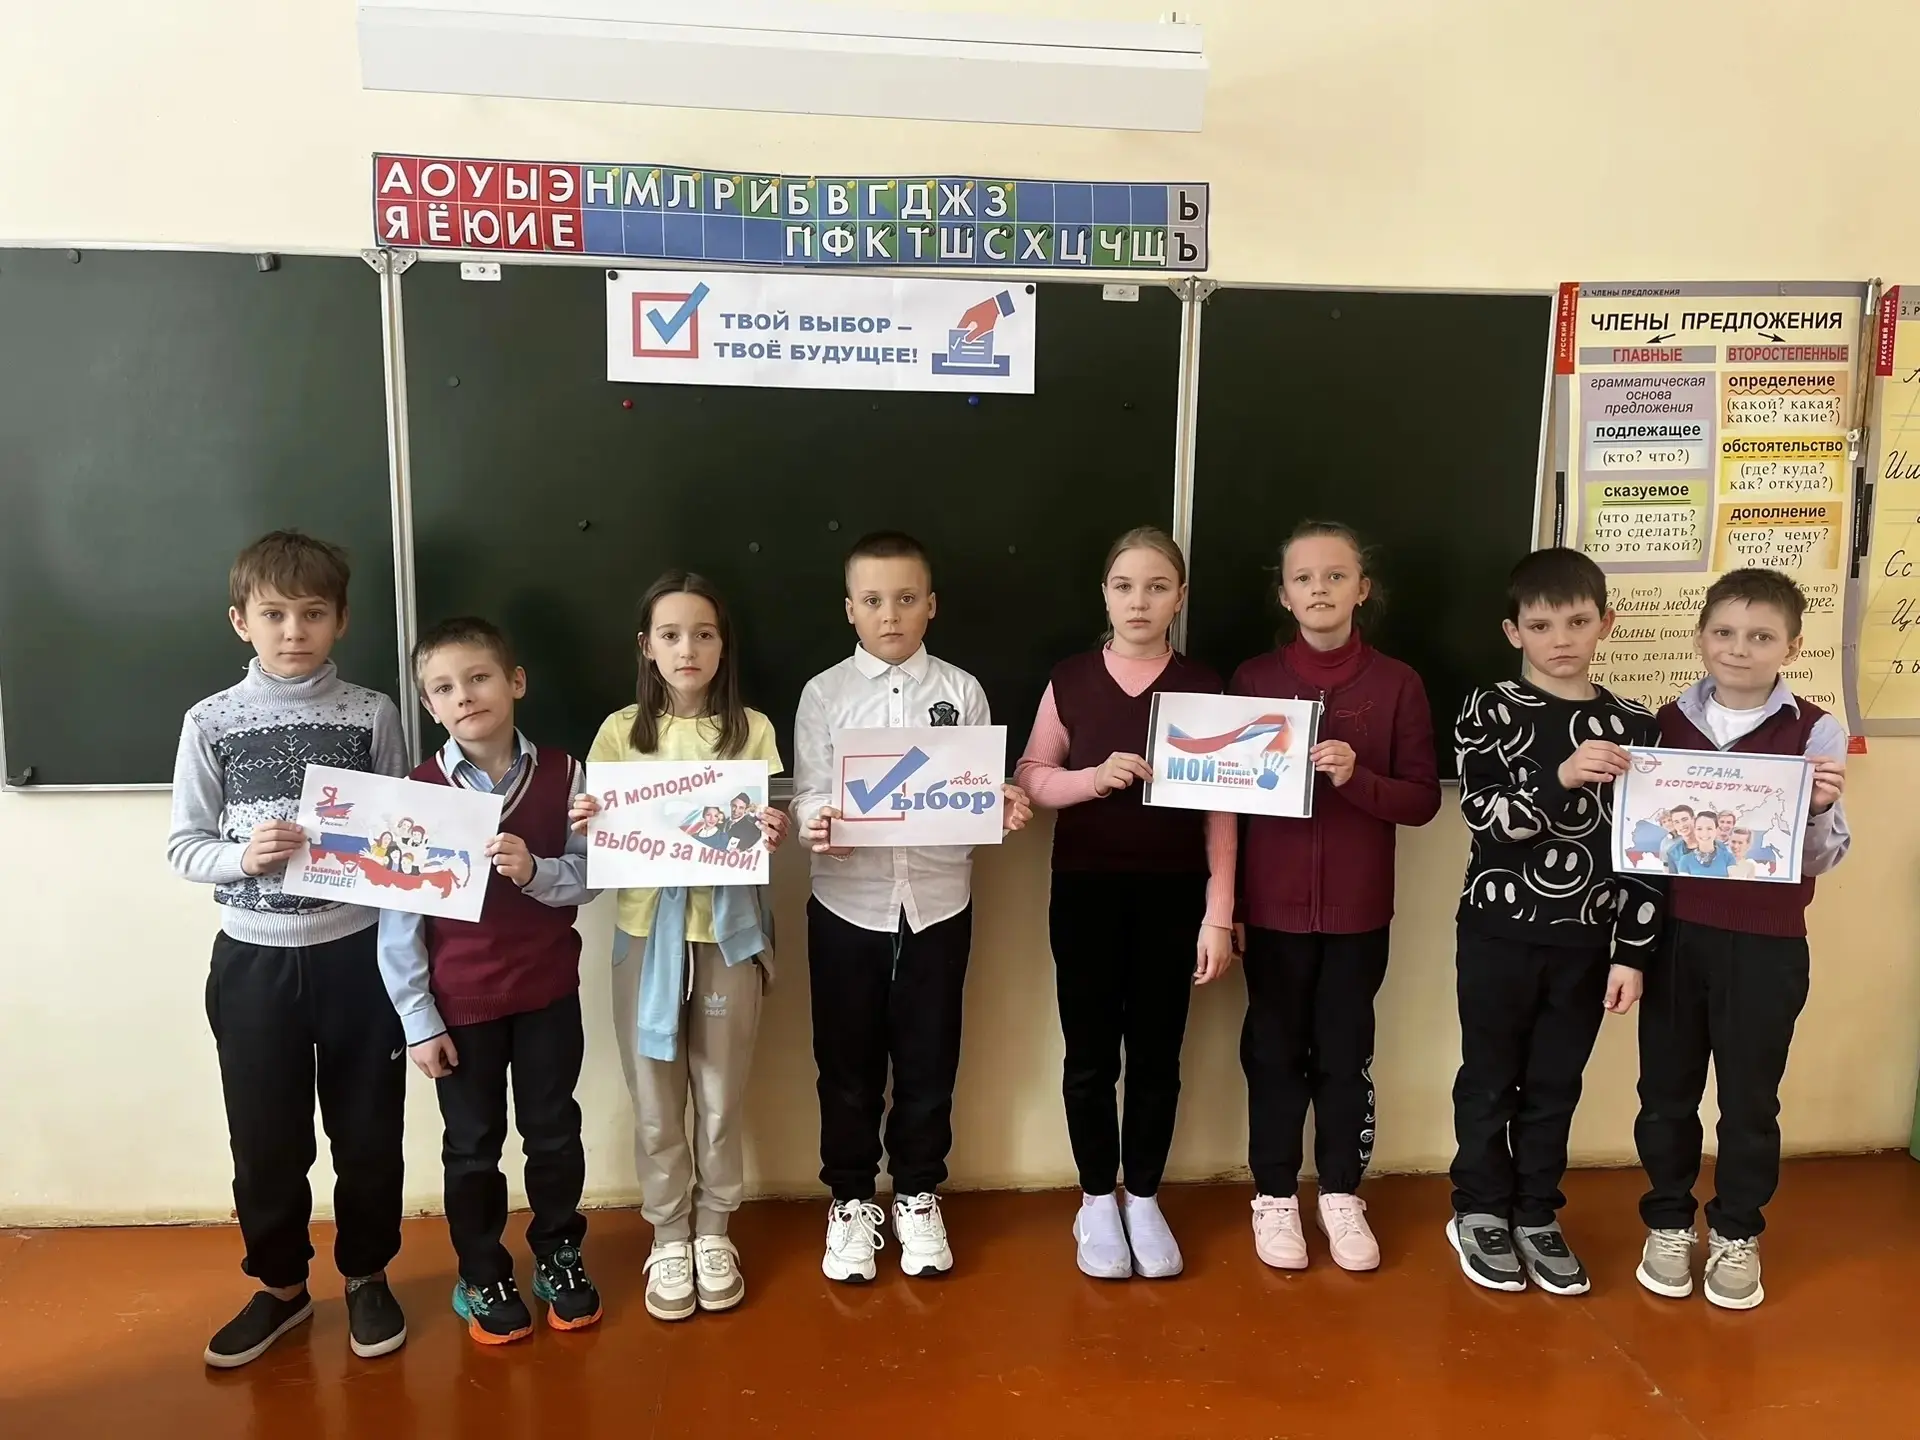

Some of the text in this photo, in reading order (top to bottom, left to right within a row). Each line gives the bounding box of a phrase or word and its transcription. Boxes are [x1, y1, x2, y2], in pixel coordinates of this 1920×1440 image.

[380, 161, 413, 195] А
[420, 163, 456, 198] О
[464, 164, 495, 199] У
[505, 167, 538, 201] Ы
[549, 169, 575, 203] Э
[586, 170, 615, 206] Н
[623, 171, 660, 207] М
[666, 174, 696, 209] Л
[714, 178, 736, 210] Р
[750, 178, 779, 214] Й
[786, 184, 812, 216] Б
[827, 185, 849, 216] В
[868, 184, 889, 216] Г
[901, 185, 932, 221] Д
[939, 184, 975, 217] Ж
[384, 203, 1199, 266] Я Ё Ю И Е П Ф К Т Ш С Х Ц Ч Щ Ъ
[1591, 289, 1620, 297] ЧЛЕНЫ
[1621, 288, 1681, 297] ПРЕДЛОЖЕНИЯ
[1900, 306, 1910, 316] 3.
[720, 310, 790, 332] ТВОЙ
[799, 316, 892, 334] ВЫБОР
[1591, 312, 1843, 333] ЧЛЕНЫ ПРЕДЛОЖЕНИЯ
[1560, 320, 1568, 358] РУССКИЙ
[1881, 327, 1889, 366] РУССКИЙ
[714, 340, 919, 366] ТВОЁ БУДУЩЕЕ!
[1613, 348, 1683, 362] ГЛАВНЫЕ
[1728, 346, 1849, 361] ВТОРОСТЕПЕННЫЕ
[1590, 377, 1706, 391] грамматическая
[1728, 375, 1836, 390] определение
[1626, 390, 1672, 401] основа
[1604, 401, 1694, 417] предложения
[1727, 396, 1841, 413] (какой? какая?
[1727, 410, 1841, 425] какое? какие?)
[1596, 425, 1701, 440] подлежащее
[1723, 438, 1843, 453] обстоятельство
[1603, 448, 1690, 467] (кто? что?)
[1740, 461, 1825, 478] (где? куда?
[1604, 484, 1690, 500] сказуемое
[1730, 476, 1834, 493] как? откуда?)
[1597, 509, 1696, 527] (что делать?
[1730, 507, 1827, 521] дополнение
[1595, 523, 1696, 539] что сделать?
[1728, 527, 1829, 545] (чего? чему?
[1583, 538, 1703, 554] кто это такой?)
[1737, 540, 1812, 554] что? чем?
[1747, 554, 1803, 568] о чём?)
[1631, 587, 1662, 599] (что?)
[1679, 586, 1708, 598] (как?
[1813, 583, 1839, 594] что?)
[1616, 598, 1660, 612] волны
[1663, 595, 1706, 611] медле
[1611, 624, 1656, 639] волны
[1610, 651, 1639, 664] (что
[1608, 671, 1666, 685] (какие?)
[1166, 755, 1217, 783] МОЙ
[1217, 767, 1251, 777] будущее
[949, 770, 992, 786] твой
[603, 765, 724, 811] Я молодой-
[1655, 778, 1774, 795] В КОТОРОЙ БУДУ ЖИТЬ
[593, 830, 762, 872] выбор за мной!
[310, 866, 342, 876] ВЫБИРАЮ
[302, 872, 357, 889] БУДУЩЕЕ!
